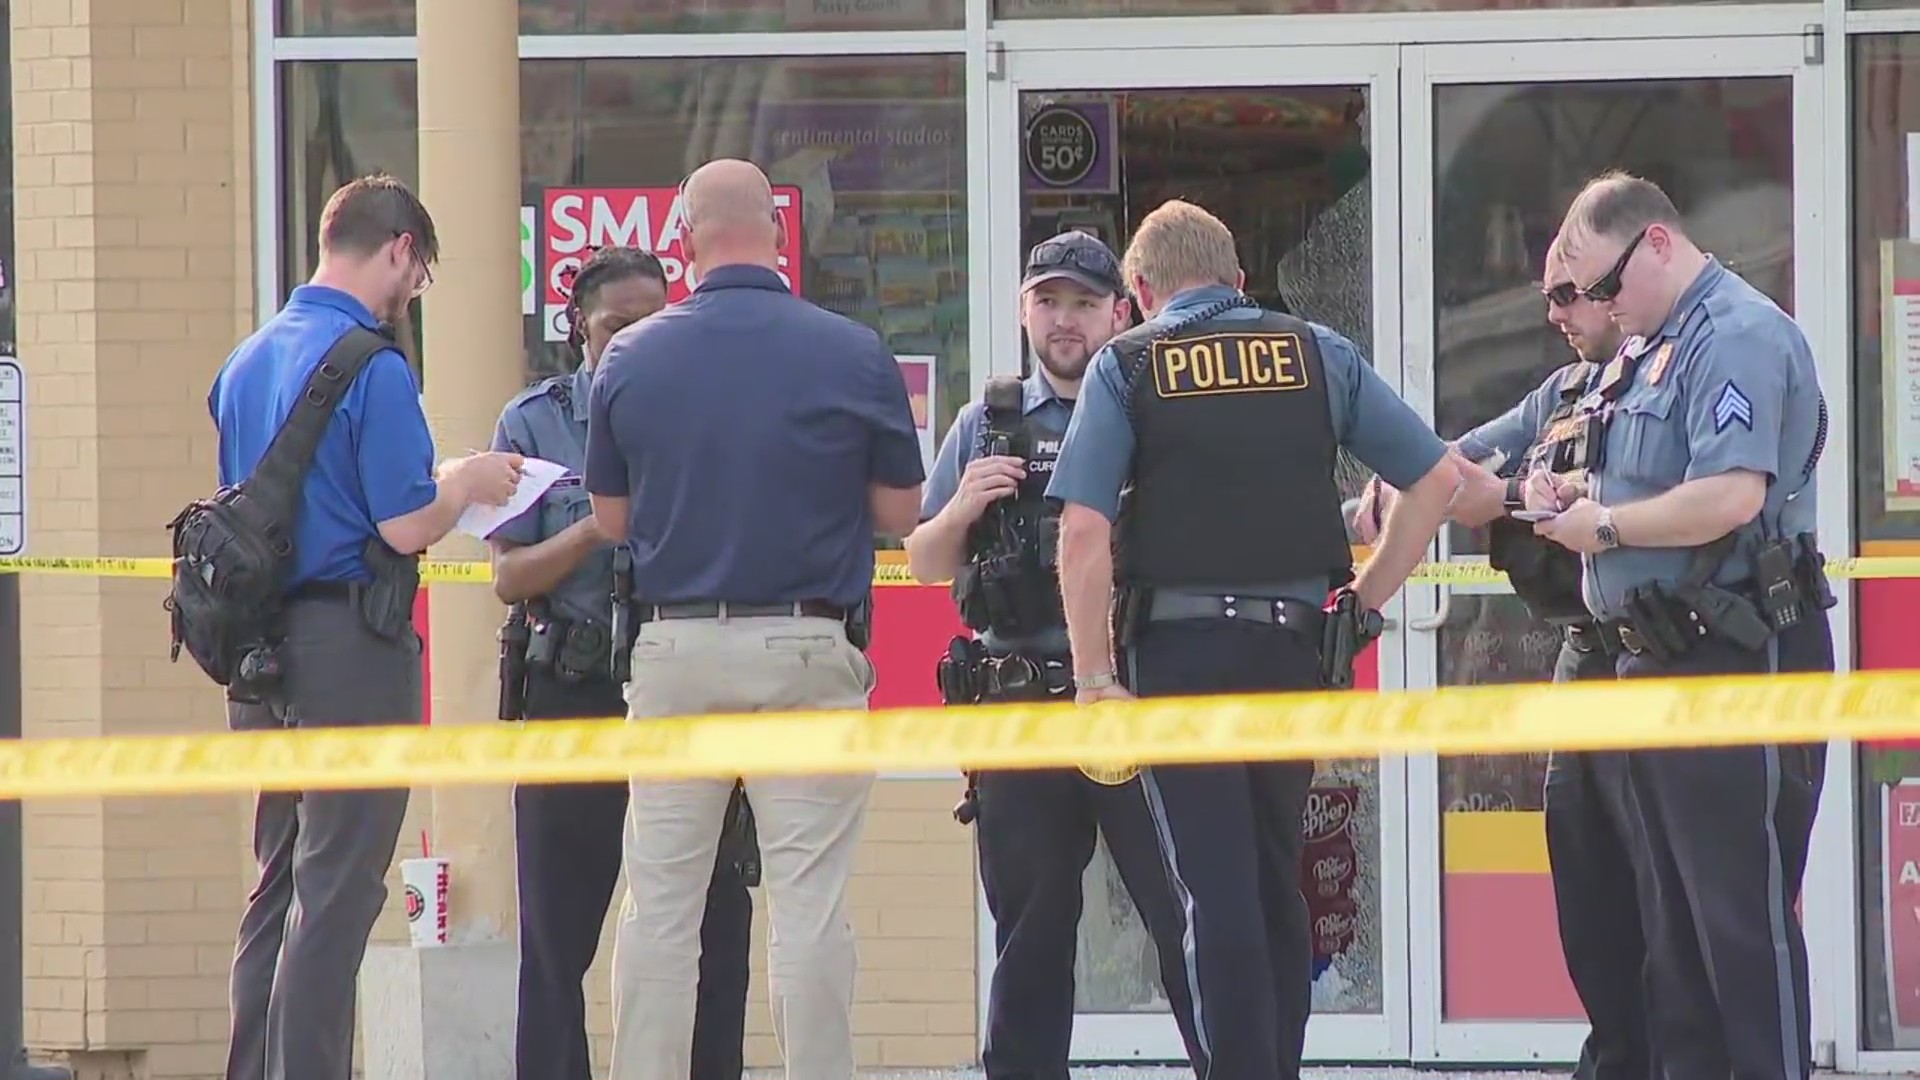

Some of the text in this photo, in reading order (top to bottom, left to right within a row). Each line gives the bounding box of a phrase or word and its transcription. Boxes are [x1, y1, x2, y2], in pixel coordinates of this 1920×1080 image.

[1040, 126, 1083, 136] CARDS
[1041, 145, 1084, 169] 50¢
[1164, 339, 1296, 391] POLICE
[1037, 440, 1061, 454] POL
[1029, 461, 1056, 472] CUR
[1307, 794, 1331, 816] Dr
